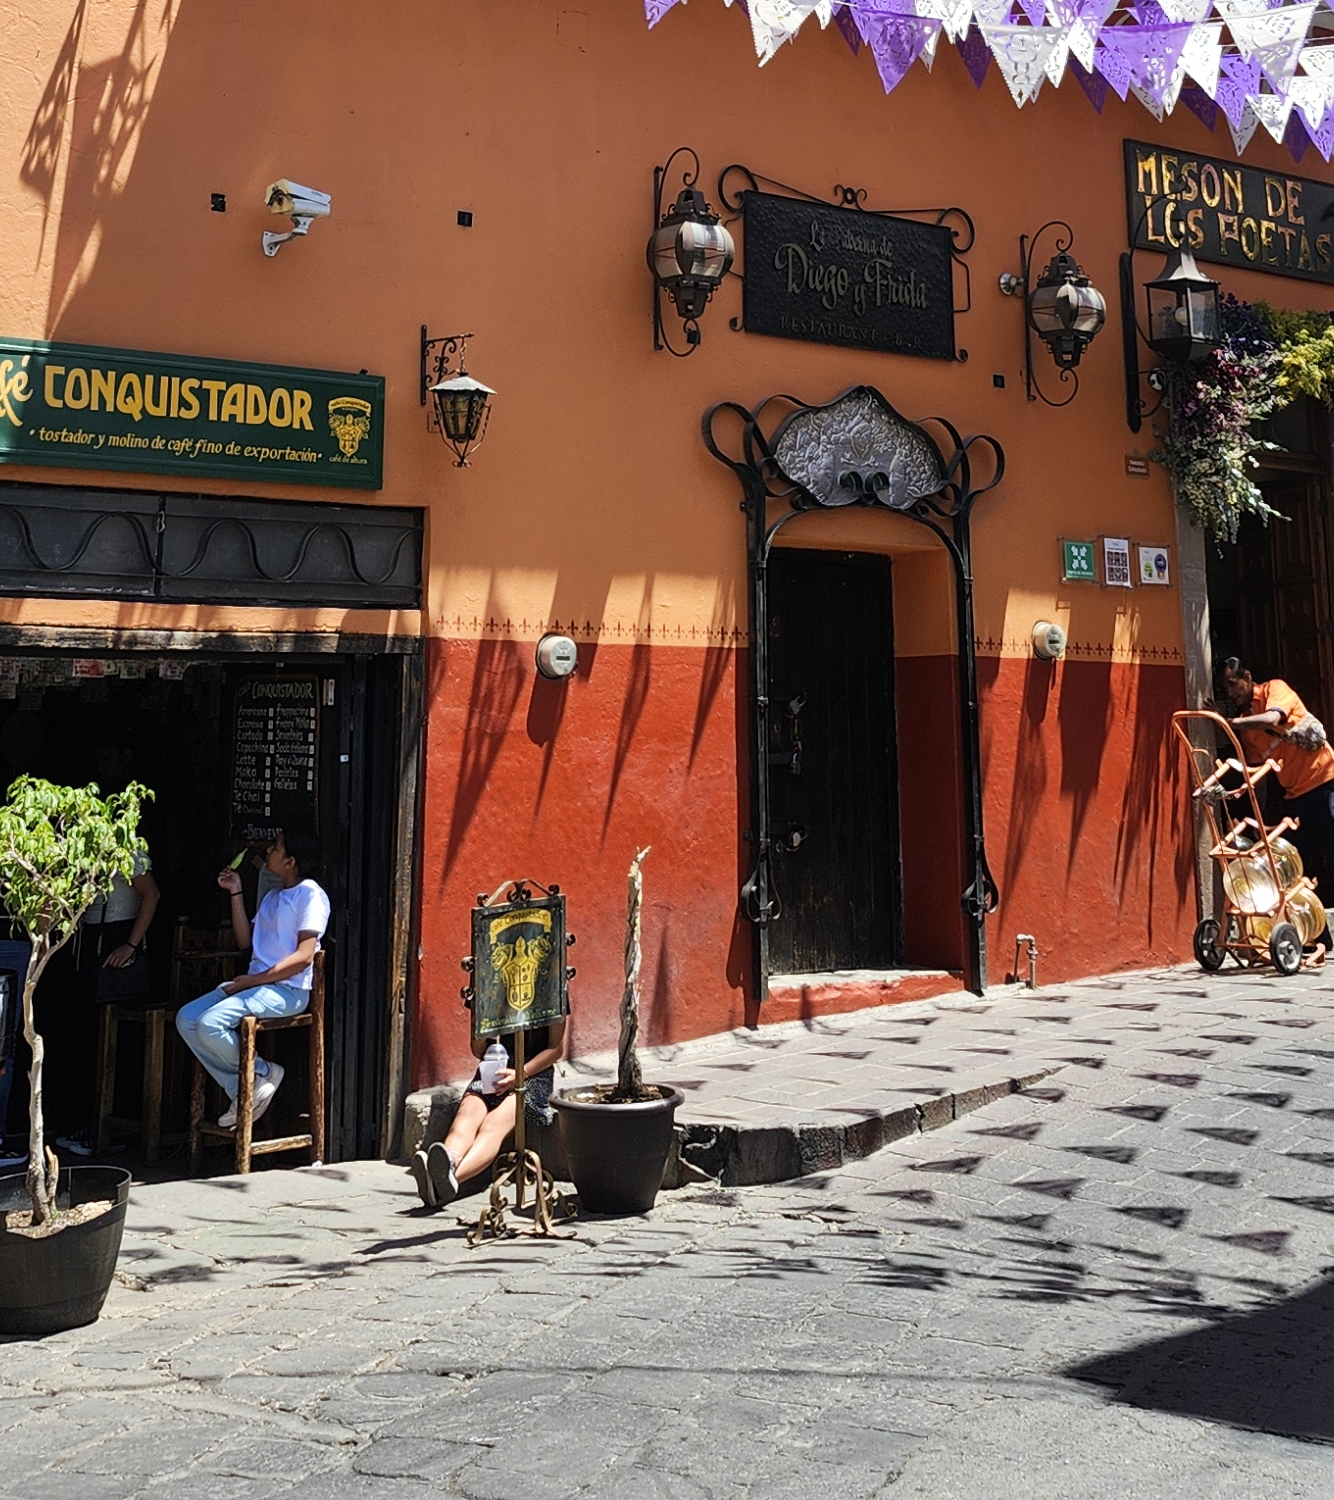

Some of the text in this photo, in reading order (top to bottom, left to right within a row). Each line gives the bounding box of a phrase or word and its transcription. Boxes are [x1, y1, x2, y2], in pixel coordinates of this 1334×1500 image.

[1136, 149, 1304, 226] MESON DE
[1217, 212, 1331, 273] POETAS
[774, 242, 928, 317] Diego y Frida
[780, 315, 878, 342] RESTAURANT
[44, 365, 314, 431] CONQUISTADOR
[39, 426, 317, 462] tostador y molino de café fino de exportación
[236, 754, 256, 765] Latte
